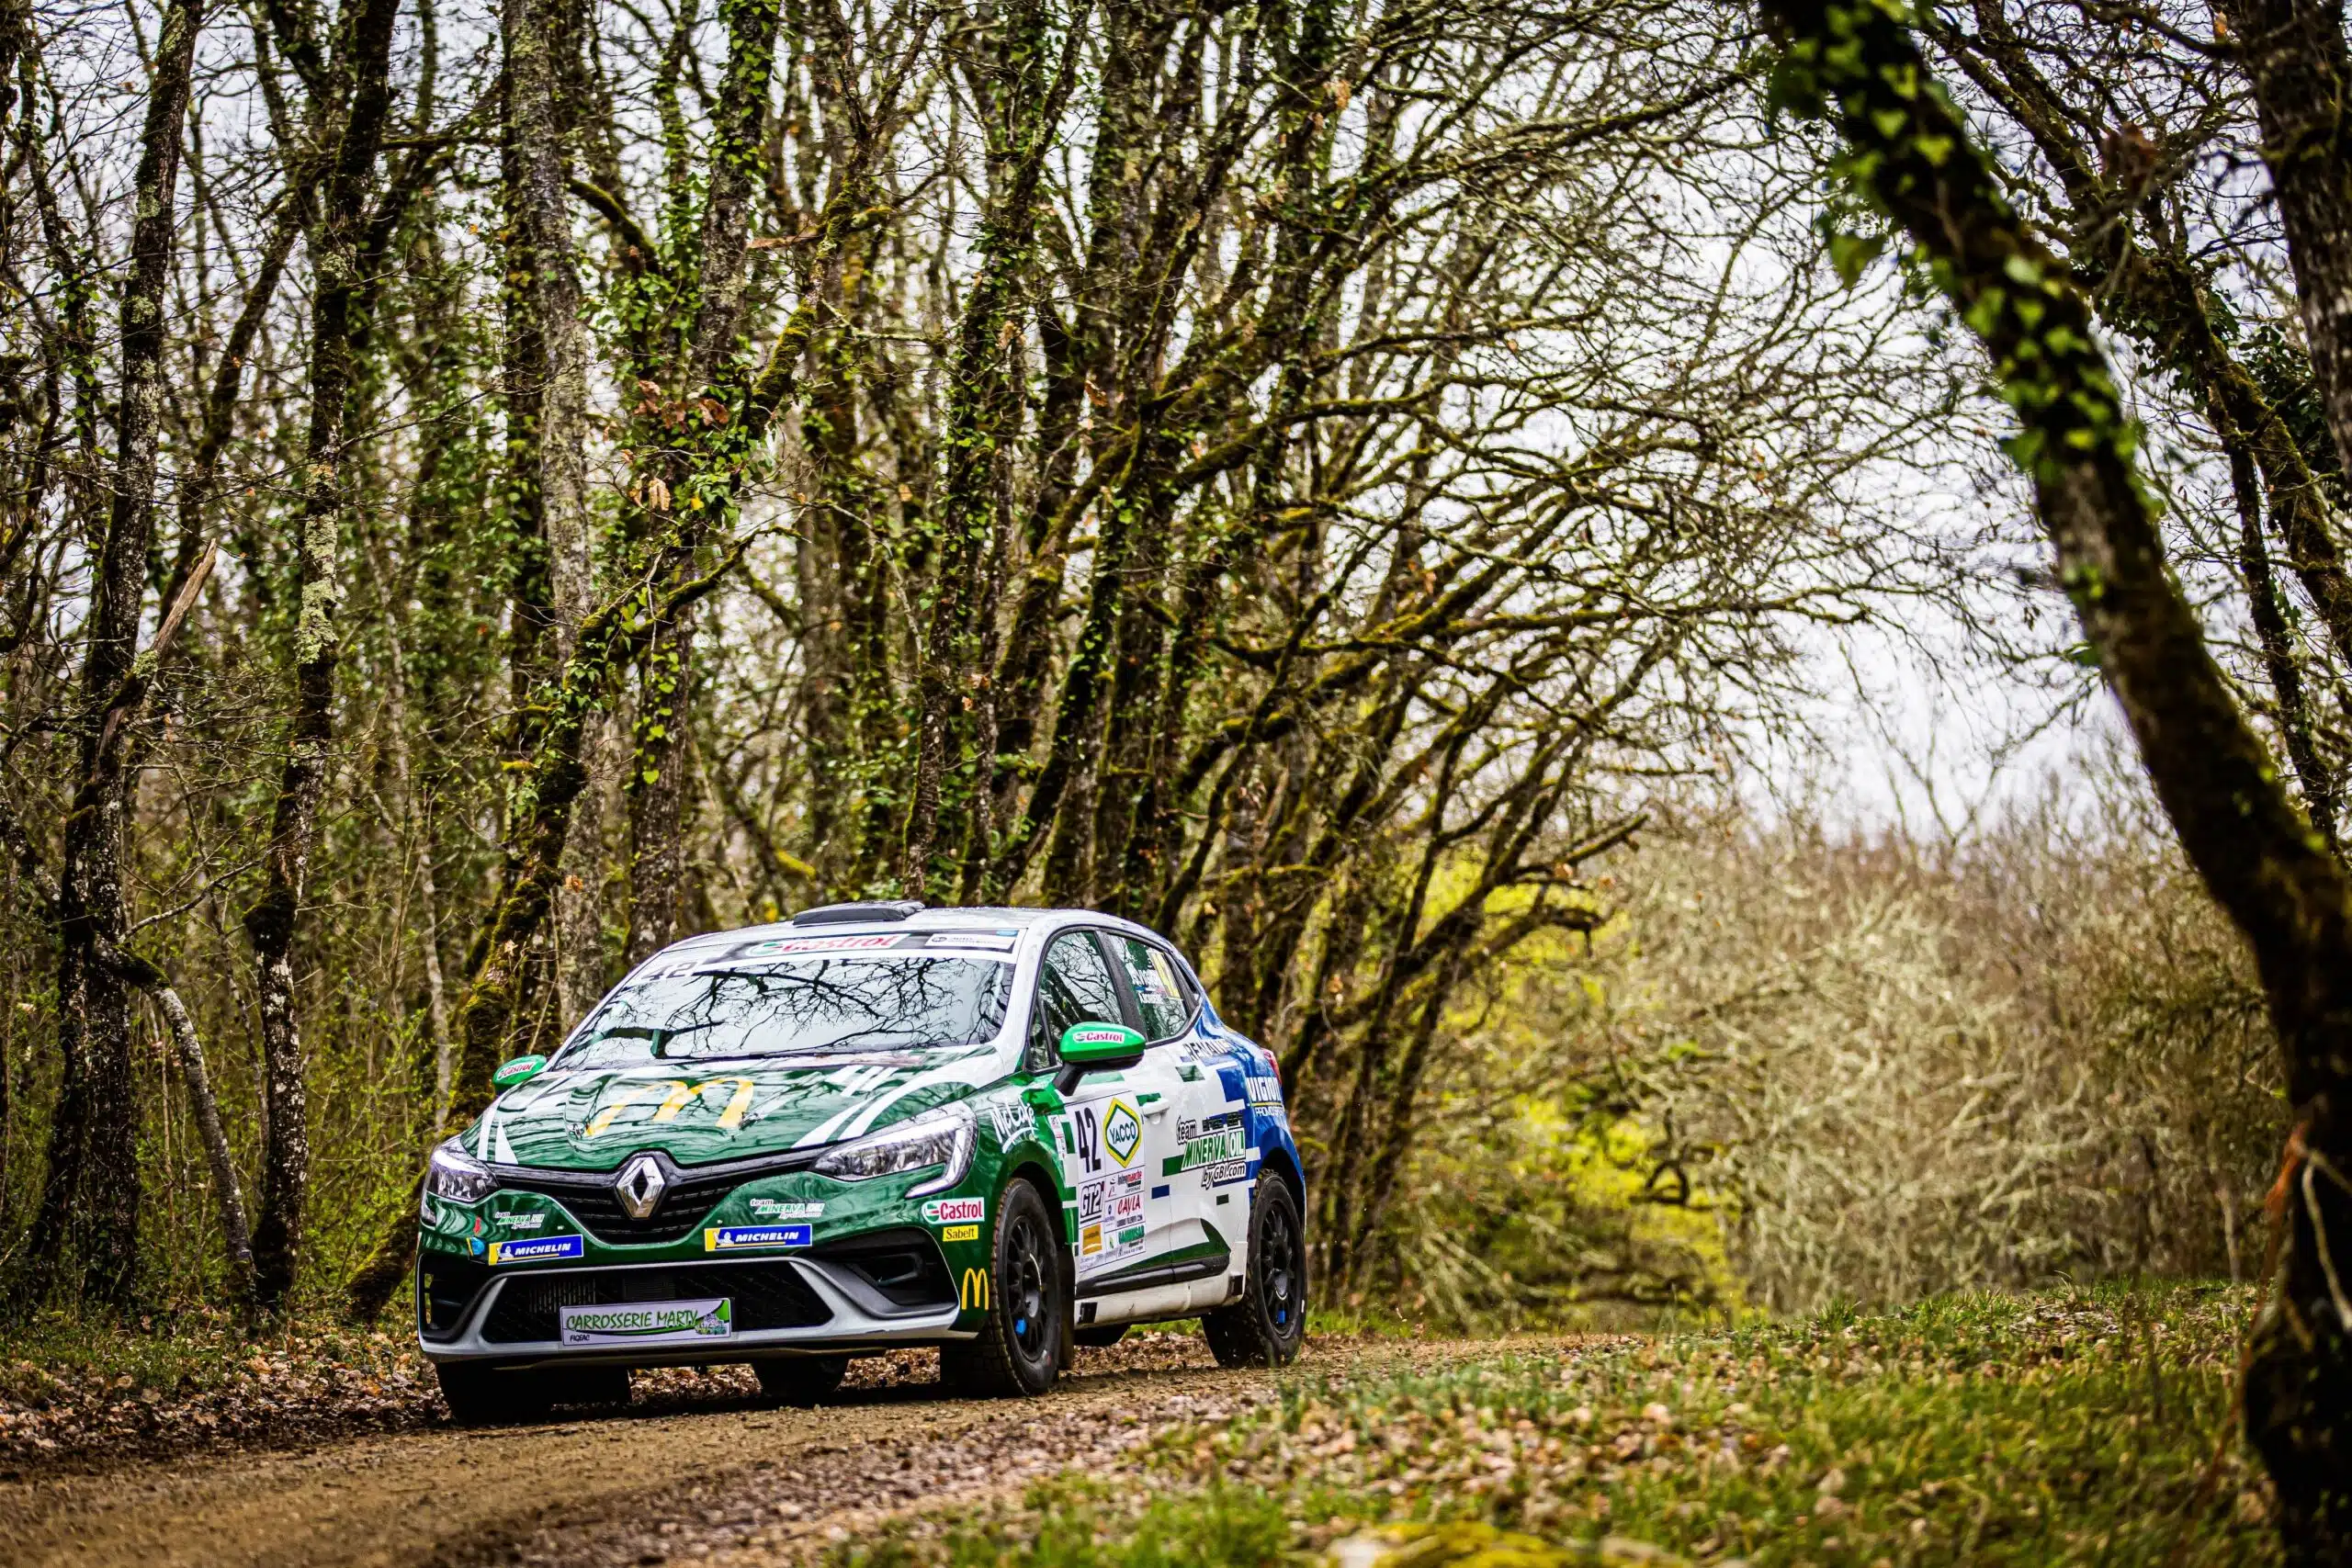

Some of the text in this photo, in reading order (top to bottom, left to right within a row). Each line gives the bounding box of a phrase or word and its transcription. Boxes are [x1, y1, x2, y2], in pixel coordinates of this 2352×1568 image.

[782, 935, 899, 953] Castrol
[641, 961, 697, 981] 42
[1086, 1032, 1123, 1042] Castrol
[1074, 1107, 1102, 1173] 42
[1109, 1121, 1136, 1145] YACCO
[1178, 1120, 1196, 1142] team
[1183, 1130, 1245, 1168] MINERVA OIL
[757, 1204, 803, 1213] MINERVA
[940, 1201, 983, 1220] Castrol
[1117, 1194, 1141, 1215] CAYLA
[735, 1231, 799, 1243] MICHELIN
[946, 1227, 975, 1239] Sabelt
[514, 1242, 571, 1256] MICHELIN
[566, 1310, 699, 1330] CARROSSERIE MARTY
[570, 1334, 591, 1342] FIGEAC
